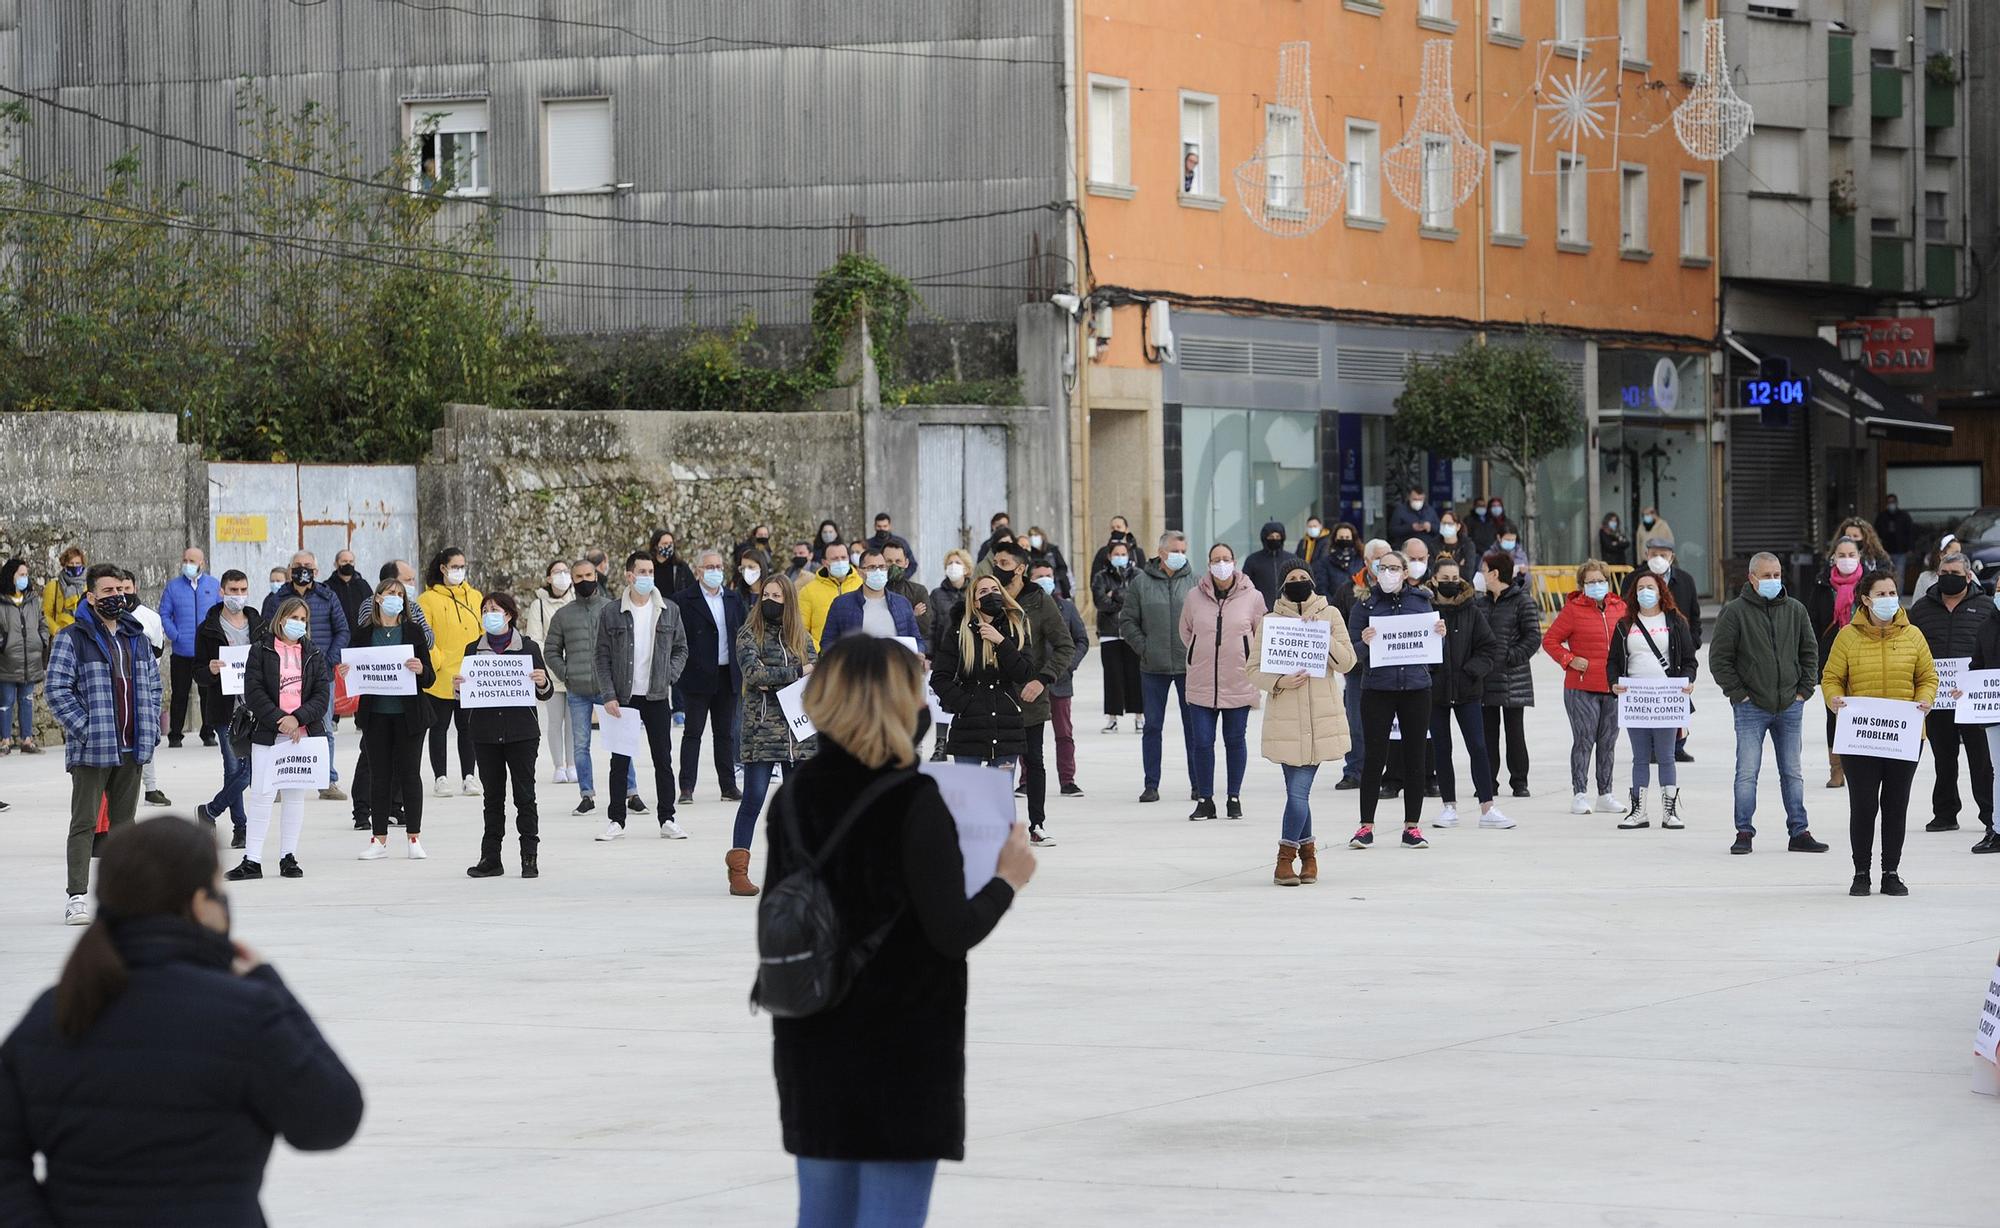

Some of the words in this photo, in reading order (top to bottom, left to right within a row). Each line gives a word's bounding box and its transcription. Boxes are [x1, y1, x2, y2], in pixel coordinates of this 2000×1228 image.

[1861, 347, 1930, 369] ASAN
[1748, 380, 1804, 404] 12:04
[1382, 632, 1397, 641] NON
[1397, 630, 1423, 639] SOMOS
[1423, 629, 1429, 637] O
[1270, 637, 1276, 645] E
[1278, 638, 1310, 648] SOBRE
[1387, 641, 1424, 651] PROBLEMA
[1268, 648, 1299, 658] TAMÉN
[231, 661, 245, 669] NON
[356, 664, 370, 672] NON
[371, 663, 396, 671] SOMOS
[397, 663, 402, 671] O
[473, 659, 490, 667] NON
[492, 659, 523, 667] SOMOS
[363, 674, 398, 682] PROBLEMA
[469, 670, 475, 678] O
[1983, 679, 1989, 687] O
[478, 690, 531, 698] HOSTALERIA
[1633, 696, 1661, 704] SOBRE
[1624, 705, 1652, 713] TAMÉN
[1654, 706, 1685, 714] COMEN
[1973, 703, 1986, 711] TEN
[1987, 703, 1993, 711] A
[1994, 702, 2000, 711] C
[793, 714, 809, 728] HO
[1852, 716, 1869, 726] NON
[1870, 717, 1900, 729] SOMOS
[1901, 720, 1907, 730] O
[1856, 729, 1899, 742] PROBLEMA
[275, 757, 286, 766] NON
[286, 755, 311, 764] SOMOS
[312, 755, 318, 763] O
[277, 767, 312, 776] PROBLEMA
